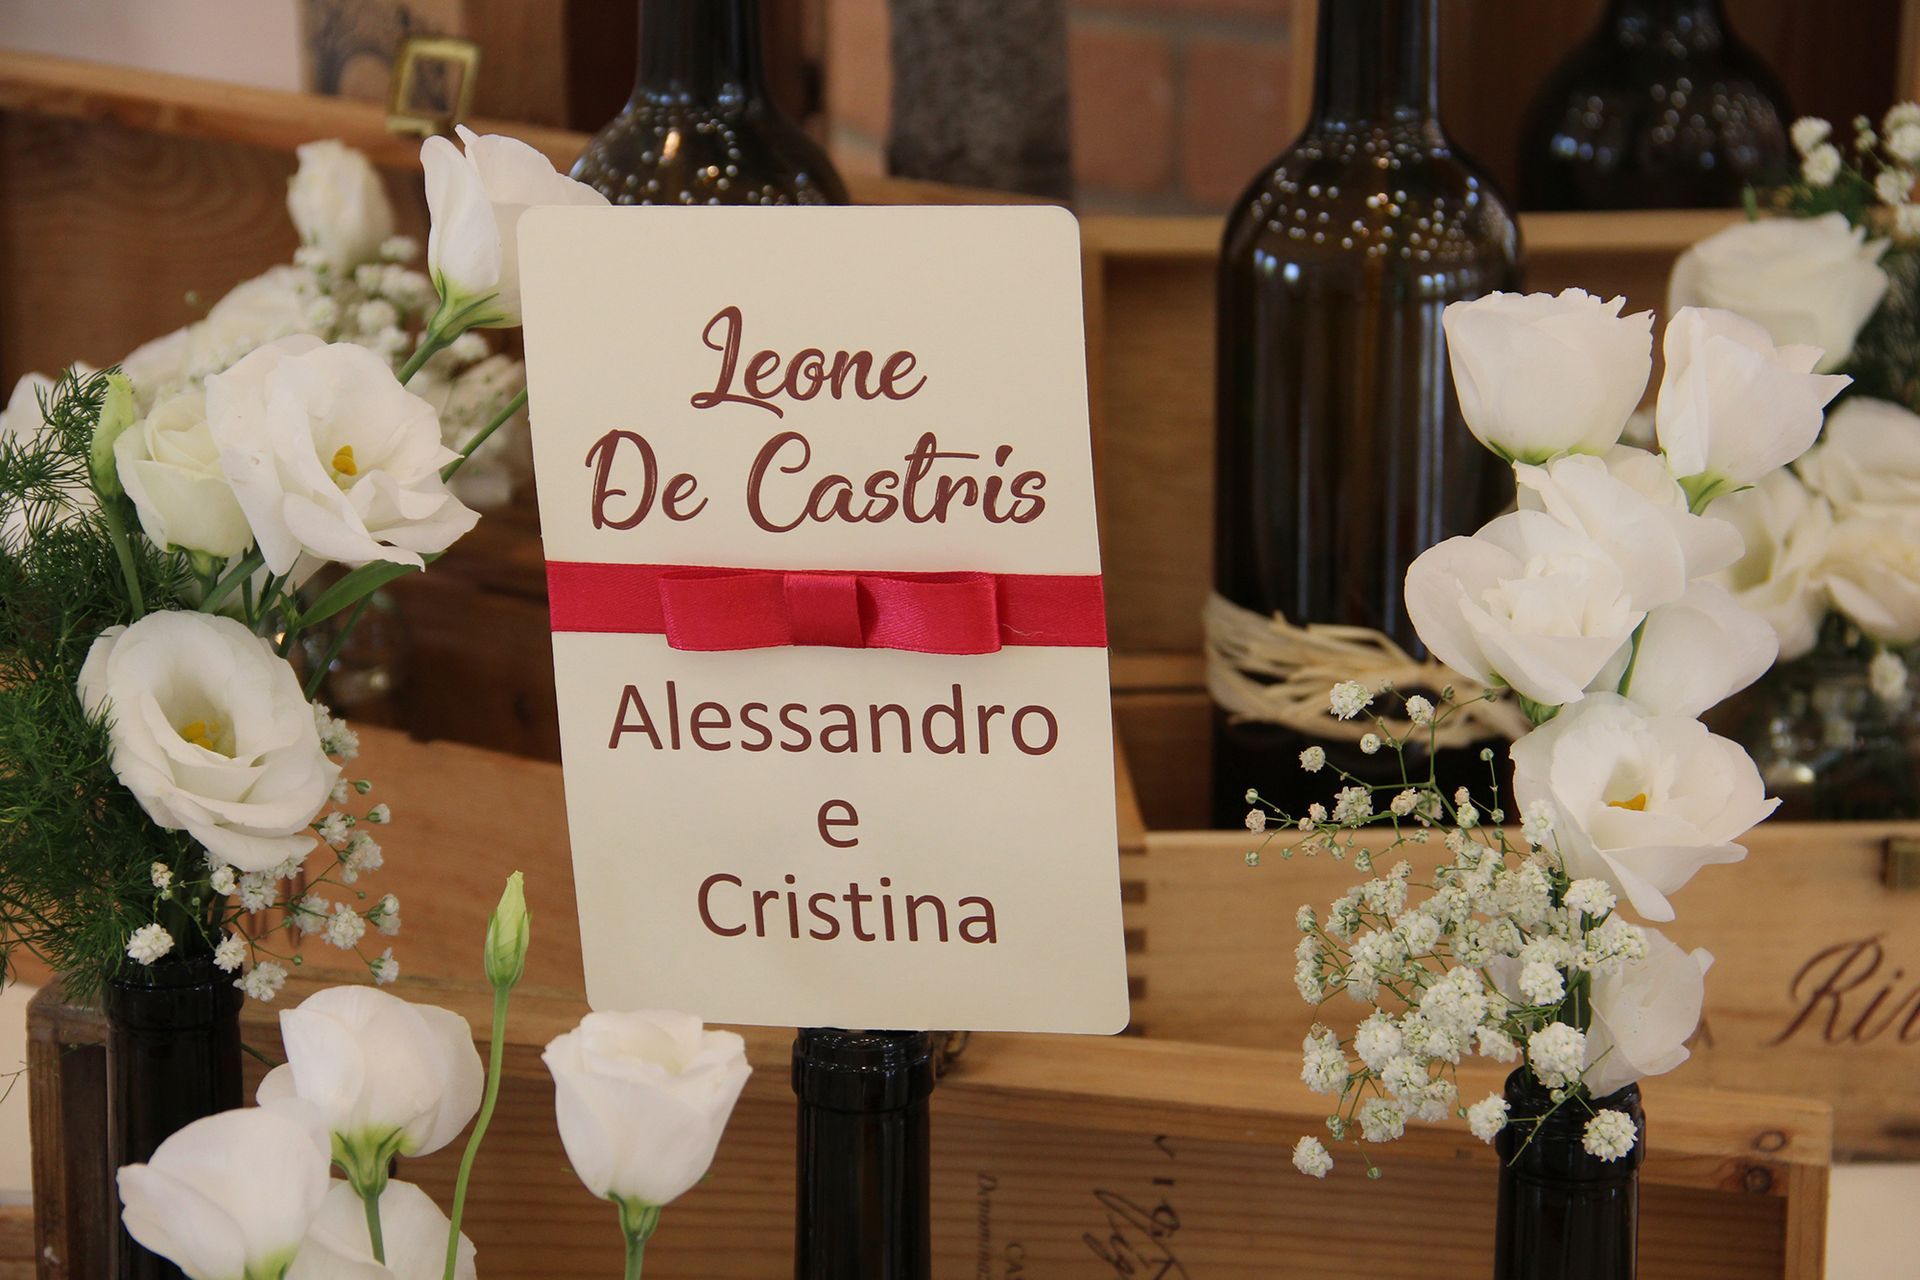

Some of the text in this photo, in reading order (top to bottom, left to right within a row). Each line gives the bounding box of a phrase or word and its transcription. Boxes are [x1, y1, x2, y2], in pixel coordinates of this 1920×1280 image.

[691, 305, 928, 420] Leone
[584, 428, 1047, 534] De Castris
[608, 680, 1059, 756] Alessandro
[817, 799, 859, 849] e
[697, 872, 998, 945] Cristina
